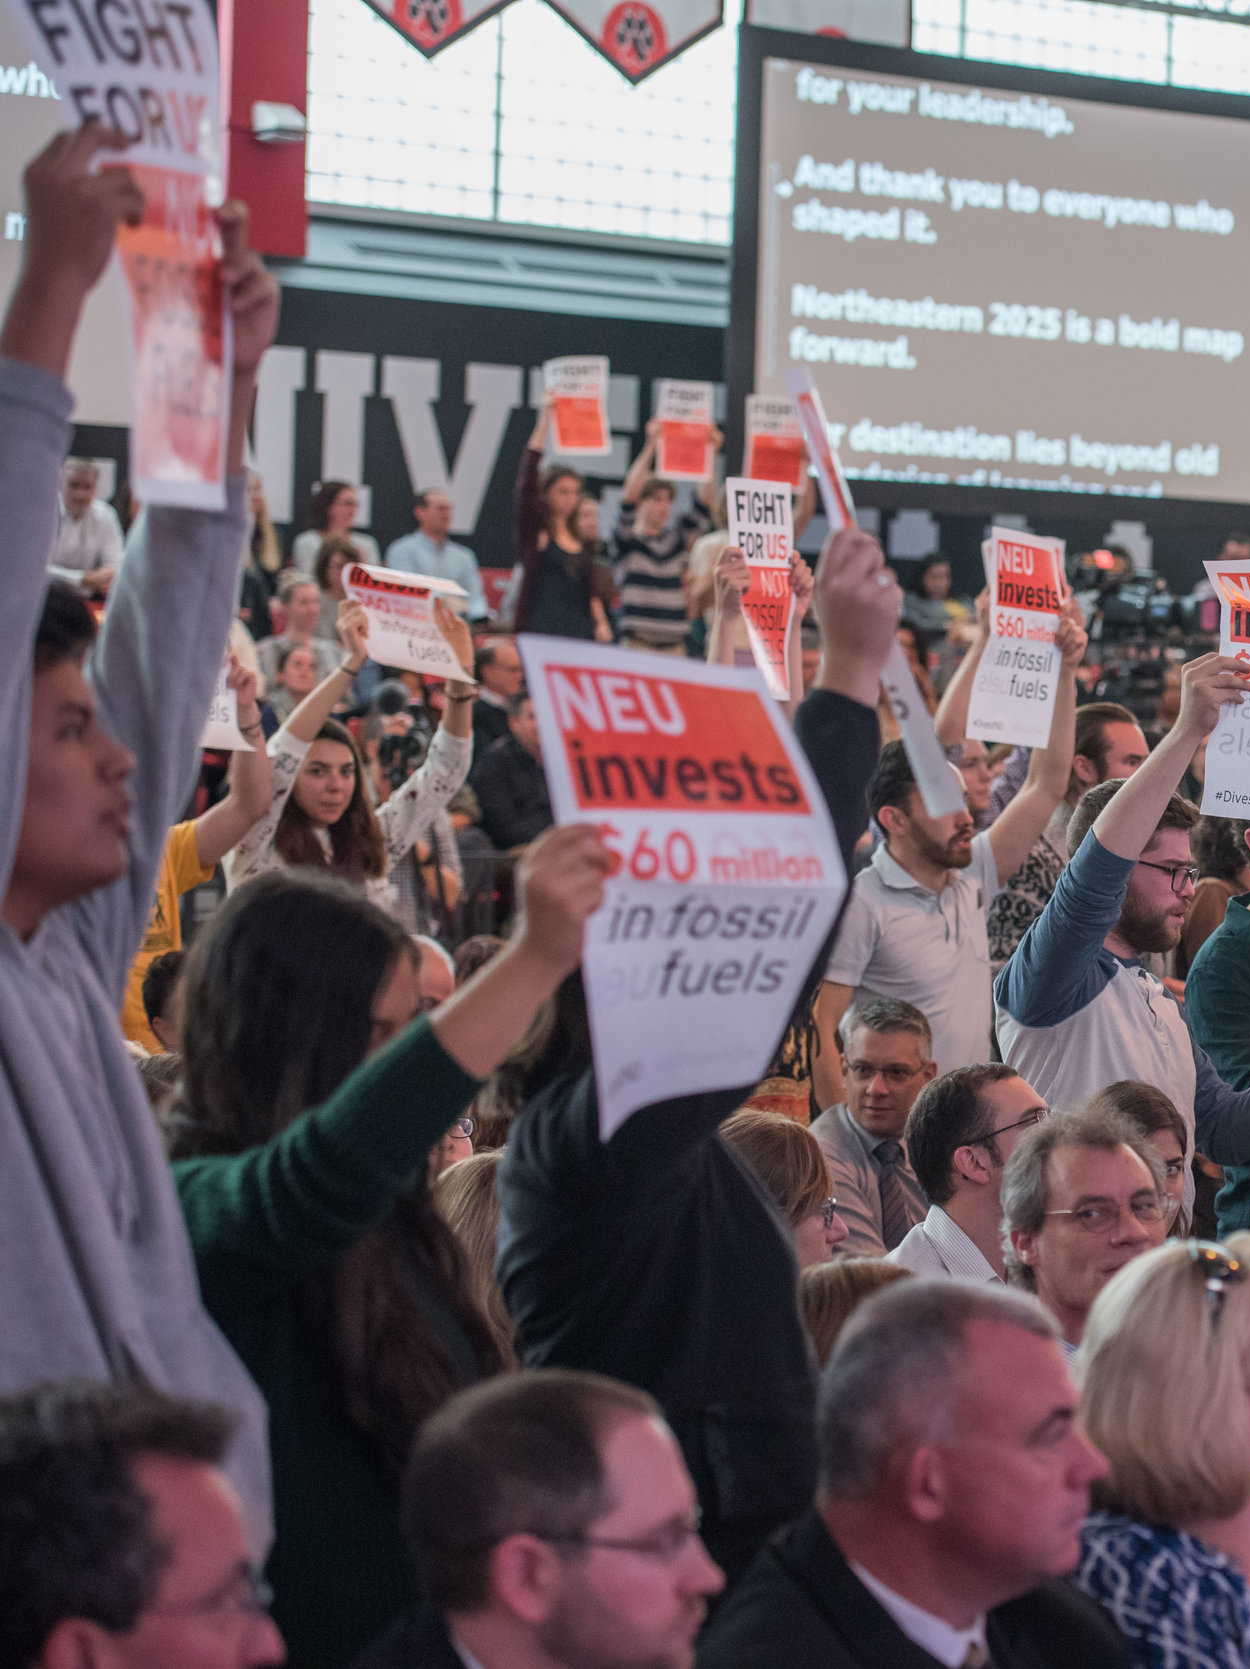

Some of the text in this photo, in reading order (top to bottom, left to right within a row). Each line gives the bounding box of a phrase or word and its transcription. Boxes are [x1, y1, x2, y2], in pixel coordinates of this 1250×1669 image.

[0, 61, 62, 100] wh
[796, 67, 1075, 139] for your leadership.
[793, 154, 1235, 236] And thank you to everyone who
[792, 198, 938, 245] shaped it.
[791, 282, 1245, 363] Northeastern 2025 is a bold map
[788, 325, 917, 371] forward.
[848, 418, 1011, 461] destination
[1015, 430, 1067, 466] lies
[1069, 434, 1171, 475] beyond
[1174, 443, 1219, 476] old
[735, 490, 785, 526] FIGHT
[738, 532, 764, 559] FOR
[999, 543, 1034, 575] NEU
[998, 575, 1060, 610] invests
[997, 612, 1024, 638] $60
[408, 639, 452, 664] fuels
[995, 644, 1052, 673] in fossil
[551, 671, 686, 737] NEU
[1009, 675, 1049, 702] fuels
[571, 738, 800, 806] invests
[598, 822, 825, 884] $60 million
[607, 893, 817, 943] in fossil
[659, 949, 788, 998] fuels
